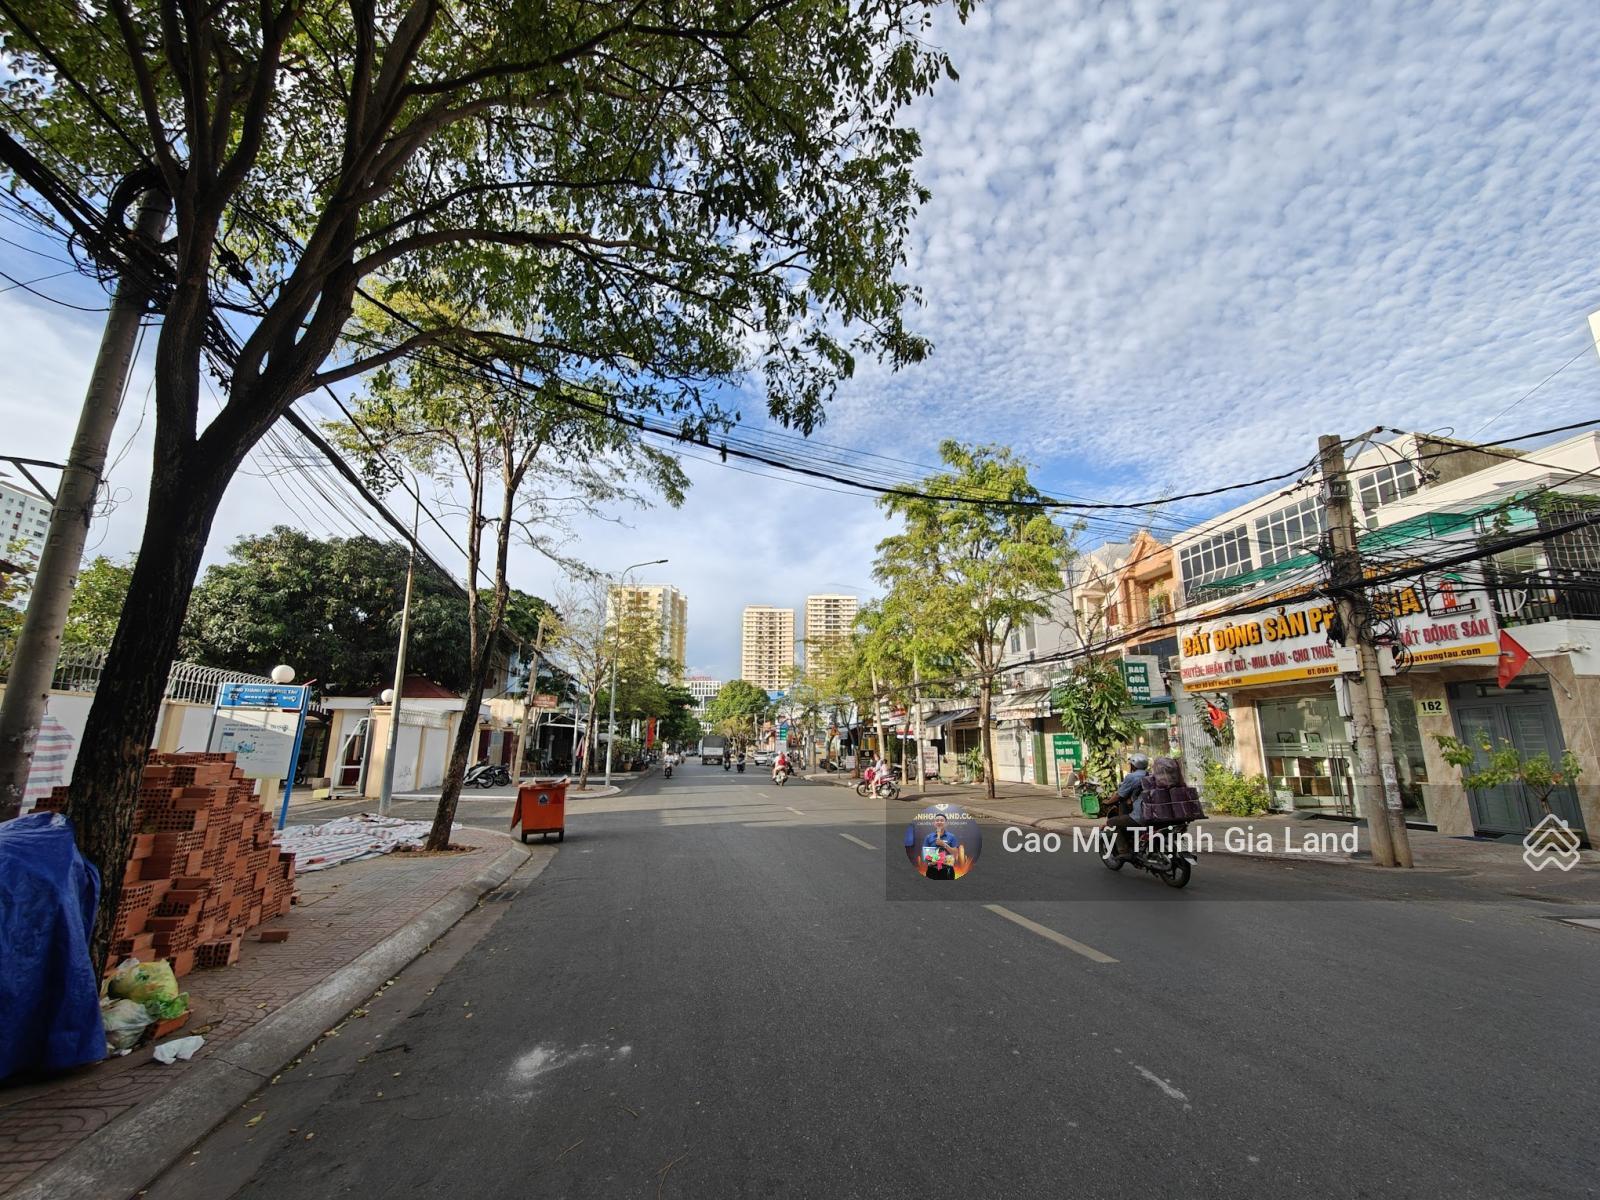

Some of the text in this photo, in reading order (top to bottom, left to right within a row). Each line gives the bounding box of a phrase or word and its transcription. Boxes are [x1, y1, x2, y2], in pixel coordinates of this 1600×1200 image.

[1182, 626, 1211, 657] BẤT
[1213, 621, 1262, 655] ĐỘNG
[1264, 607, 1308, 642] SẢN
[1251, 656, 1268, 669] MUA
[1270, 651, 1288, 666] BÁN
[1292, 647, 1311, 661] CHO
[1423, 622, 1458, 646] ĐỘNG
[1461, 615, 1491, 638] SẢN
[1421, 700, 1443, 711] 162
